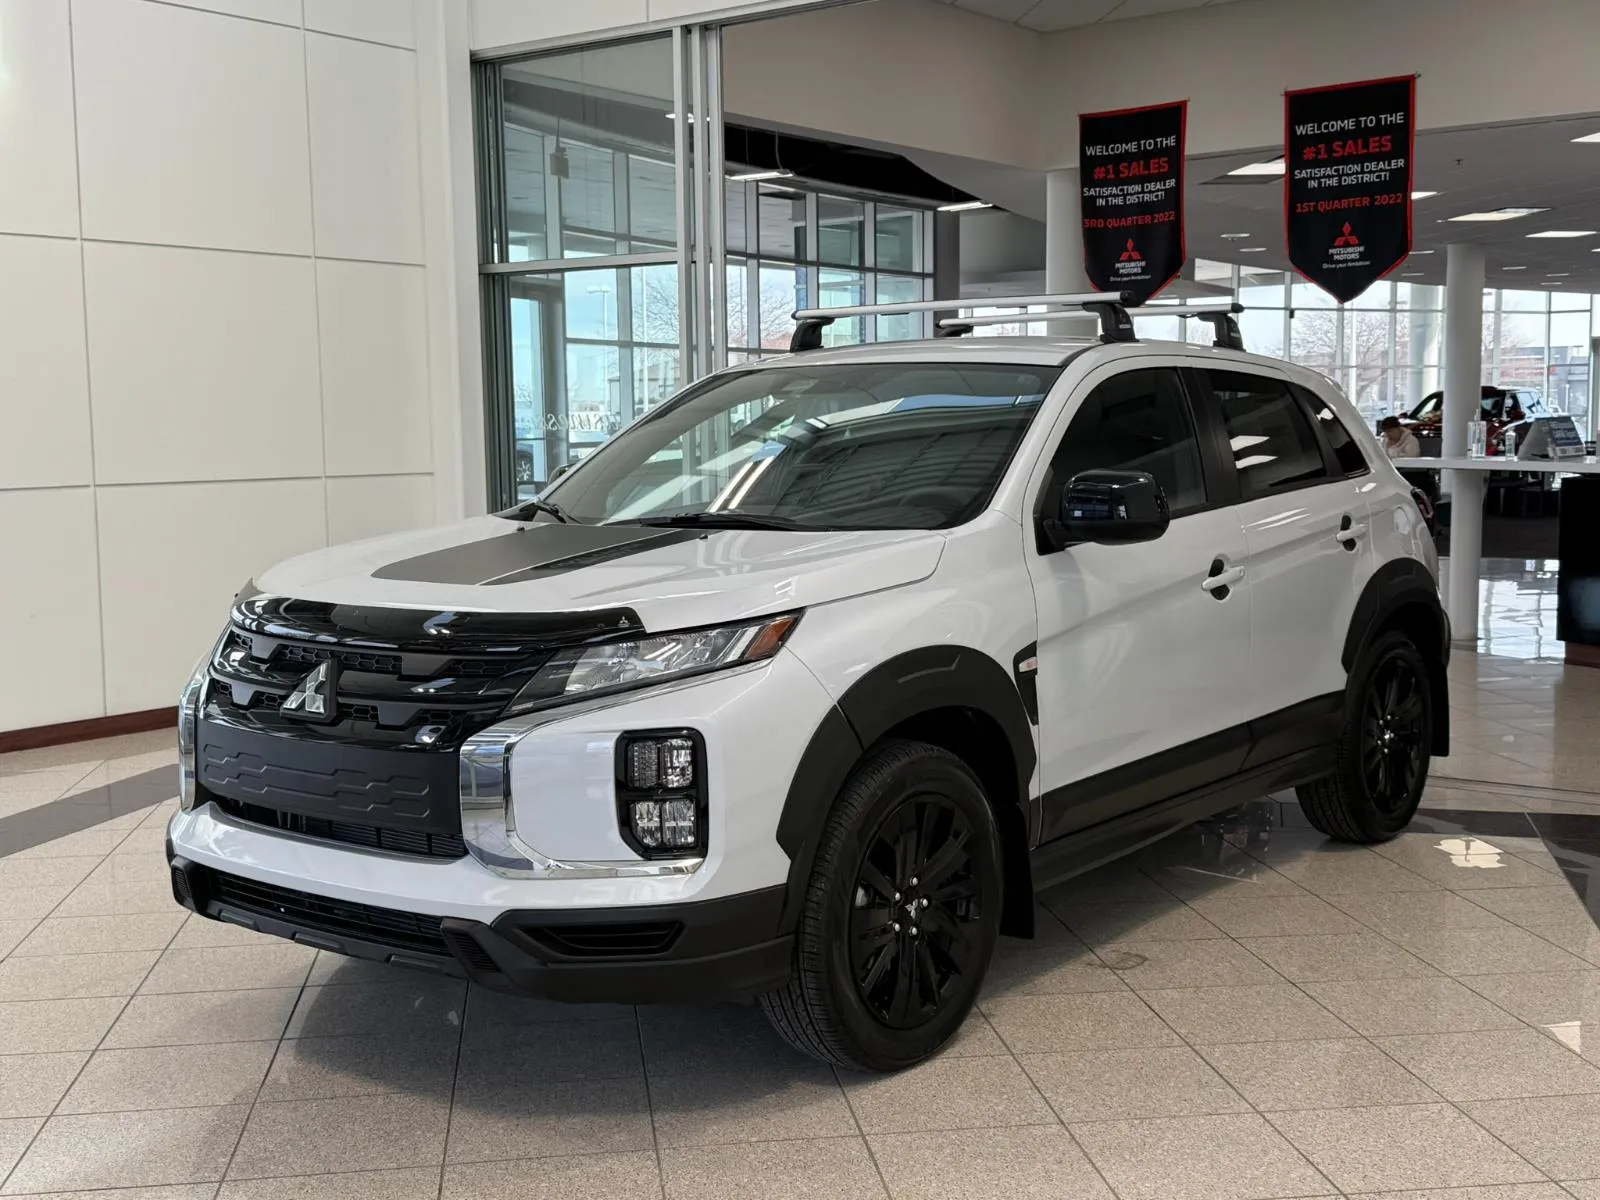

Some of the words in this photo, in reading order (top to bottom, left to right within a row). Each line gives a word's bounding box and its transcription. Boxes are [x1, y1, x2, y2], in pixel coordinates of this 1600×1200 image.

[1295, 118, 1356, 136] WELCOME
[1359, 115, 1375, 128] TO
[1379, 112, 1404, 126] THE
[1085, 141, 1138, 156] WELCOME
[1141, 138, 1154, 151] TO
[1156, 135, 1177, 147] THE
[1303, 143, 1328, 160] #1
[1332, 135, 1392, 157] SALES
[1093, 163, 1115, 180] #1
[1120, 157, 1169, 178] SALES
[1294, 164, 1361, 179] SATISFACTION
[1364, 158, 1405, 173] DEALER
[1083, 183, 1141, 196] SATISFACTION
[1144, 178, 1176, 192] DEALER
[1308, 178, 1318, 188] IN
[1321, 175, 1338, 187] THE
[1342, 171, 1390, 186] DISTRICT!
[1096, 197, 1106, 206] IN
[1108, 195, 1124, 206] THE
[1126, 191, 1165, 205] DISTRICT!
[1296, 201, 1316, 213] 1ST
[1318, 195, 1370, 214] QUARTER
[1084, 218, 1104, 228] 3RD
[1106, 214, 1151, 229] QUARTER
[1154, 211, 1175, 223] 2022
[1328, 245, 1365, 255] MITSUBISHI
[1333, 252, 1360, 261] MOTORS
